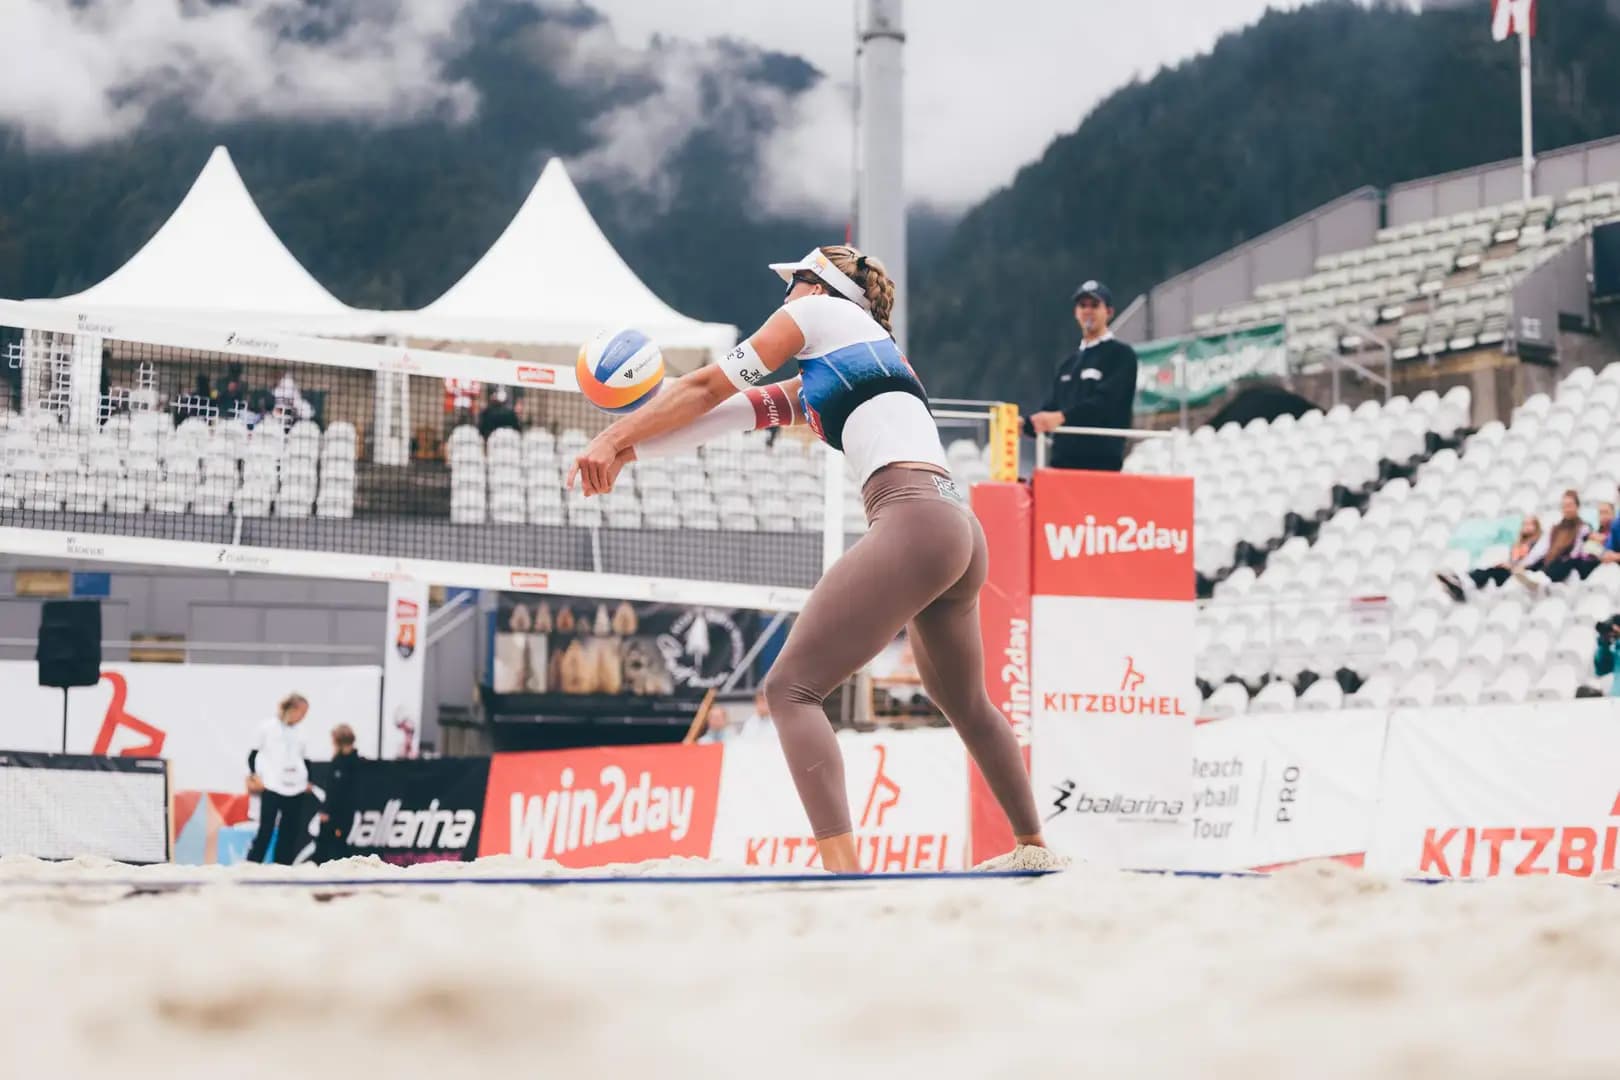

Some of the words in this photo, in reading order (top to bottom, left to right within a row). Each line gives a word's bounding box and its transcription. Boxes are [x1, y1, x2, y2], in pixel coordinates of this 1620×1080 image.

[1044, 514, 1188, 561] win2day
[510, 764, 695, 861] win2day
[1076, 793, 1184, 816] ballarina
[1276, 766, 1300, 823] PRO
[1192, 817, 1233, 839] Tour
